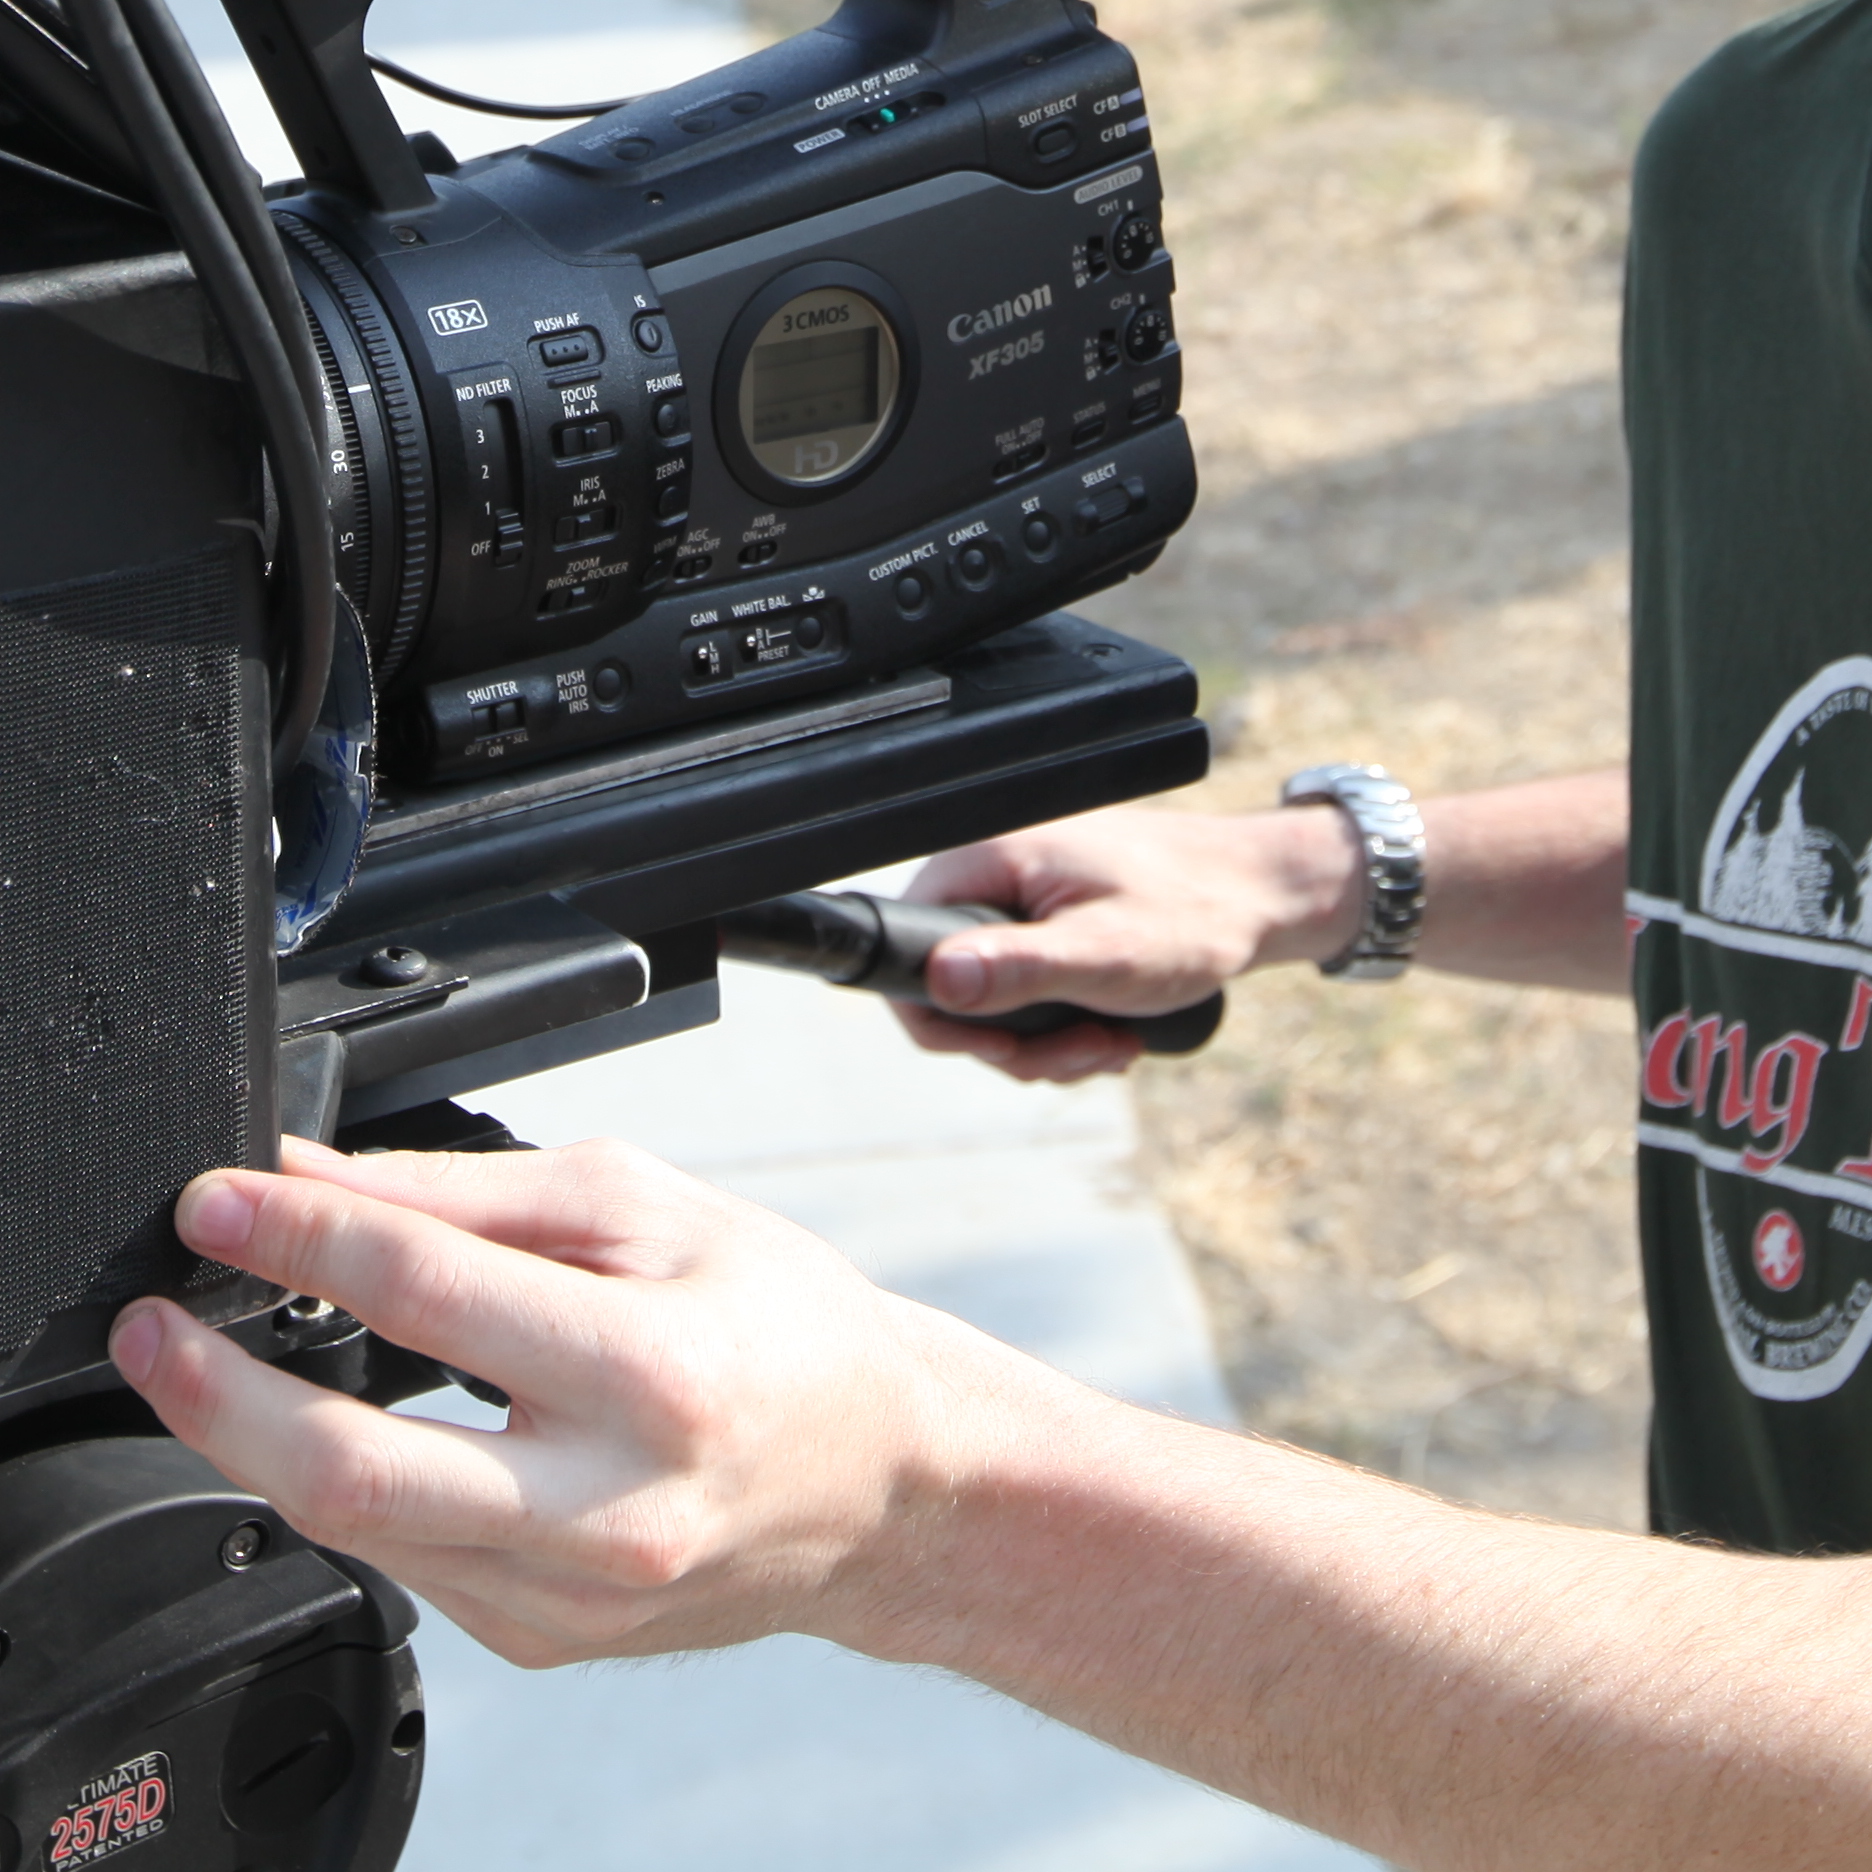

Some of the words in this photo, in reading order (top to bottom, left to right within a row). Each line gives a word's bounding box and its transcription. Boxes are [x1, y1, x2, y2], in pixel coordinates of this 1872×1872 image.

[815, 83, 860, 111] CAMERA
[862, 75, 882, 93] OFF
[884, 63, 919, 85] MEDIA
[1018, 108, 1042, 128] SLOT
[1043, 94, 1079, 119] SELECT
[797, 129, 841, 152] POWER
[1098, 199, 1119, 216] CH1
[633, 295, 646, 308] IS
[533, 315, 564, 333] PUSH
[565, 312, 580, 328] AF
[947, 284, 1053, 343] Canon
[968, 330, 1045, 380] XF305
[456, 385, 474, 402] ND
[476, 378, 512, 398] FILTER
[561, 384, 598, 403] FOCUS
[646, 373, 683, 394] PEAKING
[475, 429, 486, 444] 3
[331, 449, 348, 474] 30
[794, 440, 839, 474] HD
[481, 465, 490, 480] 2
[655, 458, 685, 481] ZEBRA
[1081, 463, 1117, 488] SELECT
[580, 476, 600, 491] IRIS
[484, 501, 492, 516] 1
[1021, 497, 1041, 515] SET
[752, 514, 776, 529] AWB
[340, 531, 354, 552] 15
[686, 528, 710, 544] AGC
[947, 521, 989, 547] CANCEL
[471, 541, 491, 557] OFF
[565, 557, 600, 575] ZOOM
[869, 554, 912, 581] CUSTOM
[913, 542, 938, 564] PICT.
[546, 574, 573, 591] RING
[586, 561, 628, 580] ROCKER
[732, 598, 767, 618] WHITE
[768, 593, 792, 612] BAL.
[690, 610, 718, 627] GAIN
[757, 645, 789, 661] PRESET
[556, 669, 586, 687] PUSH
[466, 680, 518, 705] SHUTTER
[558, 685, 588, 703] AUTO
[569, 700, 590, 714] IRIS
[488, 745, 504, 758] ON
[1640, 1002, 1830, 1178] ong
[67, 1755, 159, 1810] TIMATE
[50, 1777, 166, 1863] 2575D
[56, 1818, 164, 1872] PATENTED
